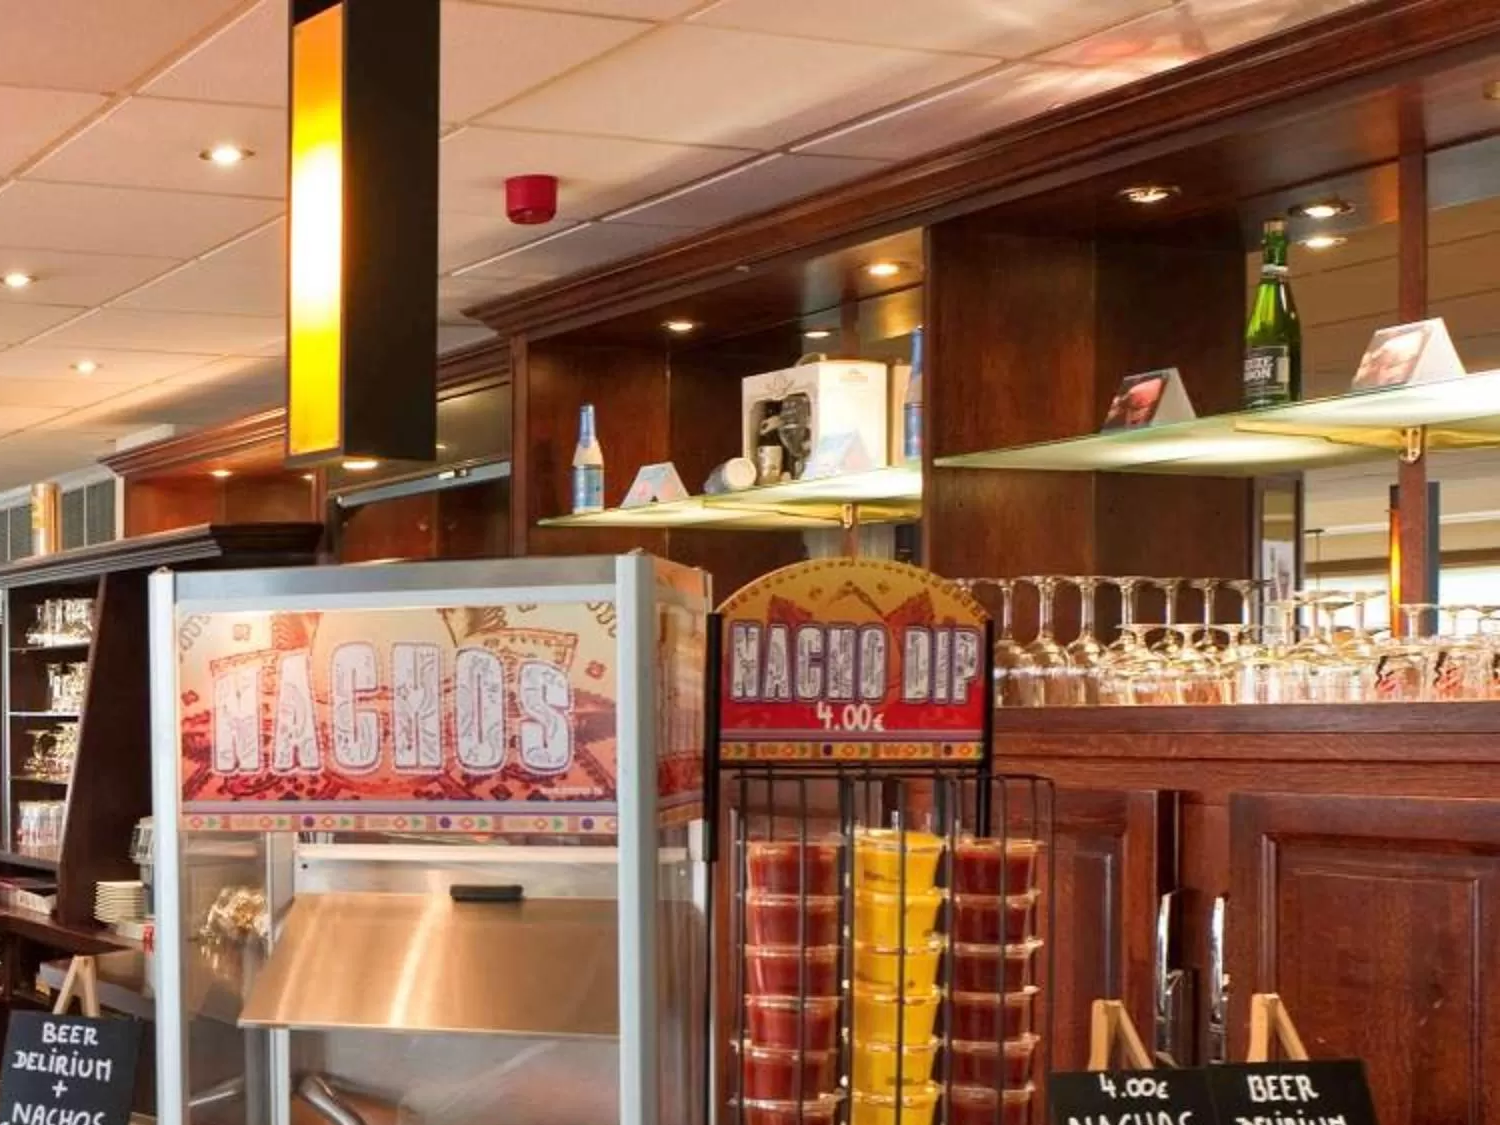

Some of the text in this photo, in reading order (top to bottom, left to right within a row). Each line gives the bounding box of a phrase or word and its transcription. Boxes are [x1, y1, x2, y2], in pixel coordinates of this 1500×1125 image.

[730, 622, 887, 702] NACHO
[903, 625, 980, 703] DIP
[212, 643, 573, 776] NACHOS
[815, 700, 884, 732] 4.00€
[41, 1021, 99, 1046] BEER
[1099, 1072, 1169, 1099] 4.00€
[1247, 1074, 1320, 1103] BEER
